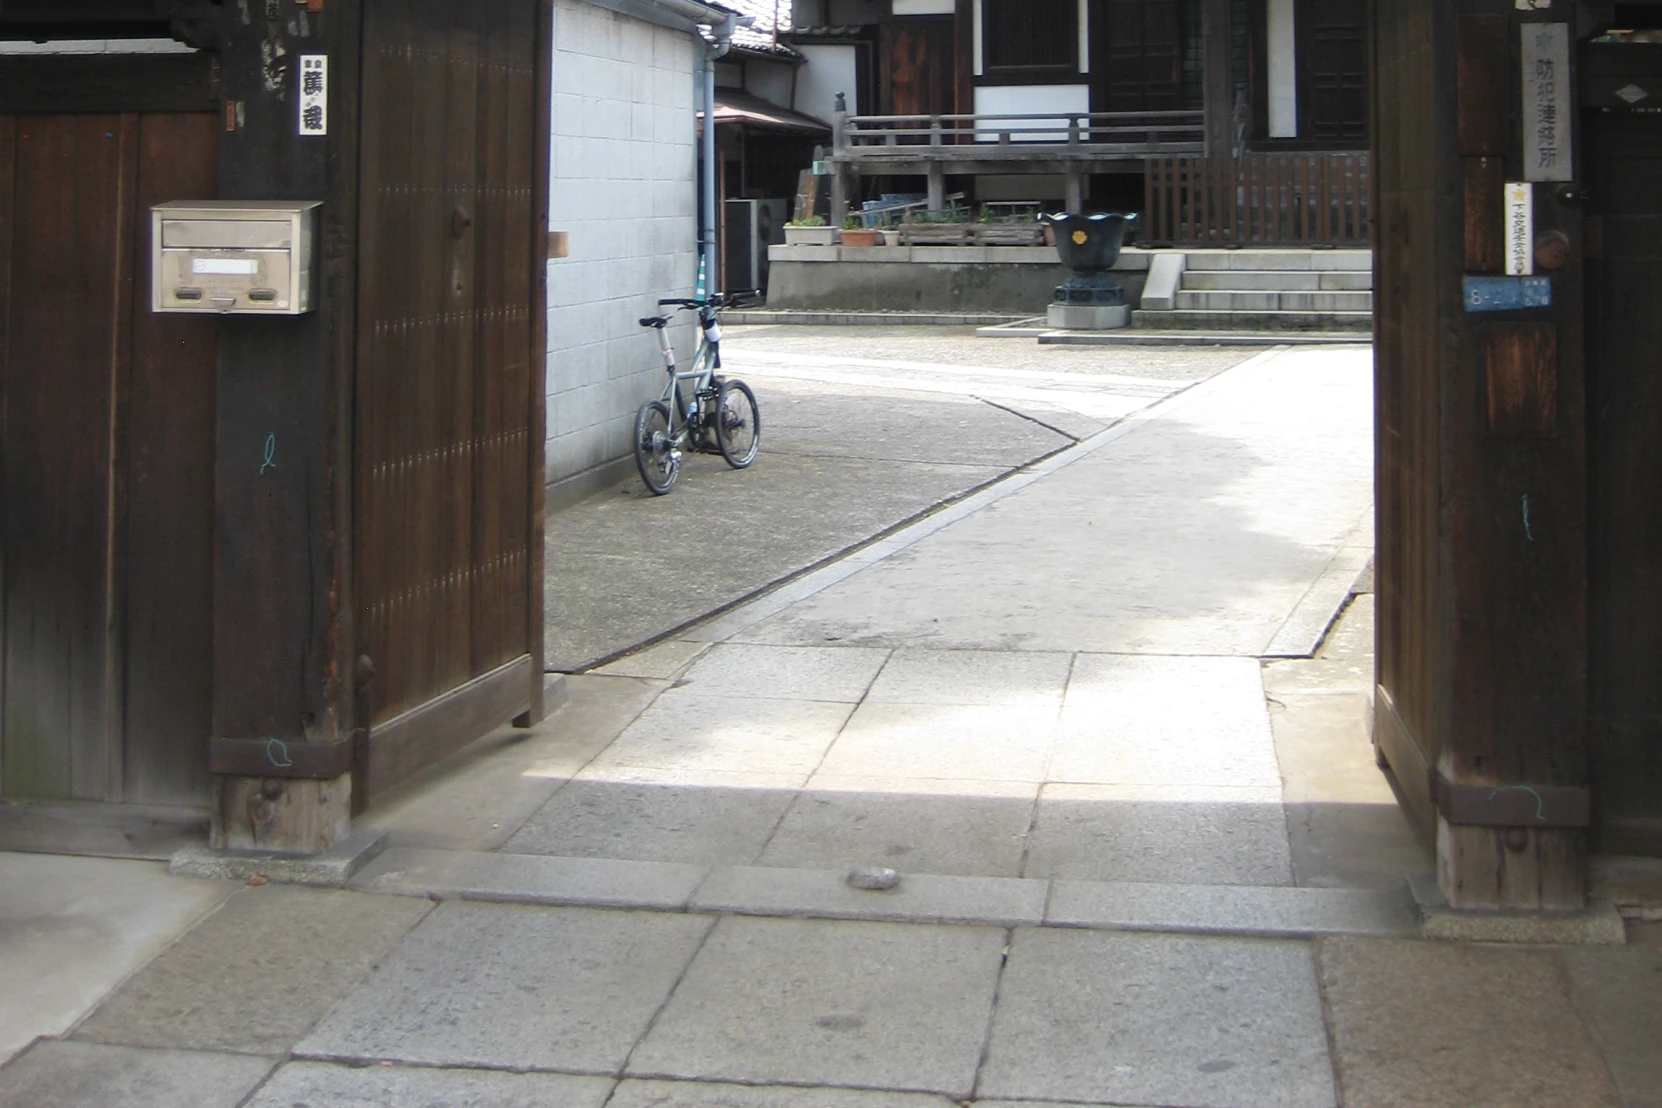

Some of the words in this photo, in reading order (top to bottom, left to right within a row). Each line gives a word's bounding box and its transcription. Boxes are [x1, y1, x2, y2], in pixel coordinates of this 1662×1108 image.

[1535, 58, 1558, 169] 防犯連絡所
